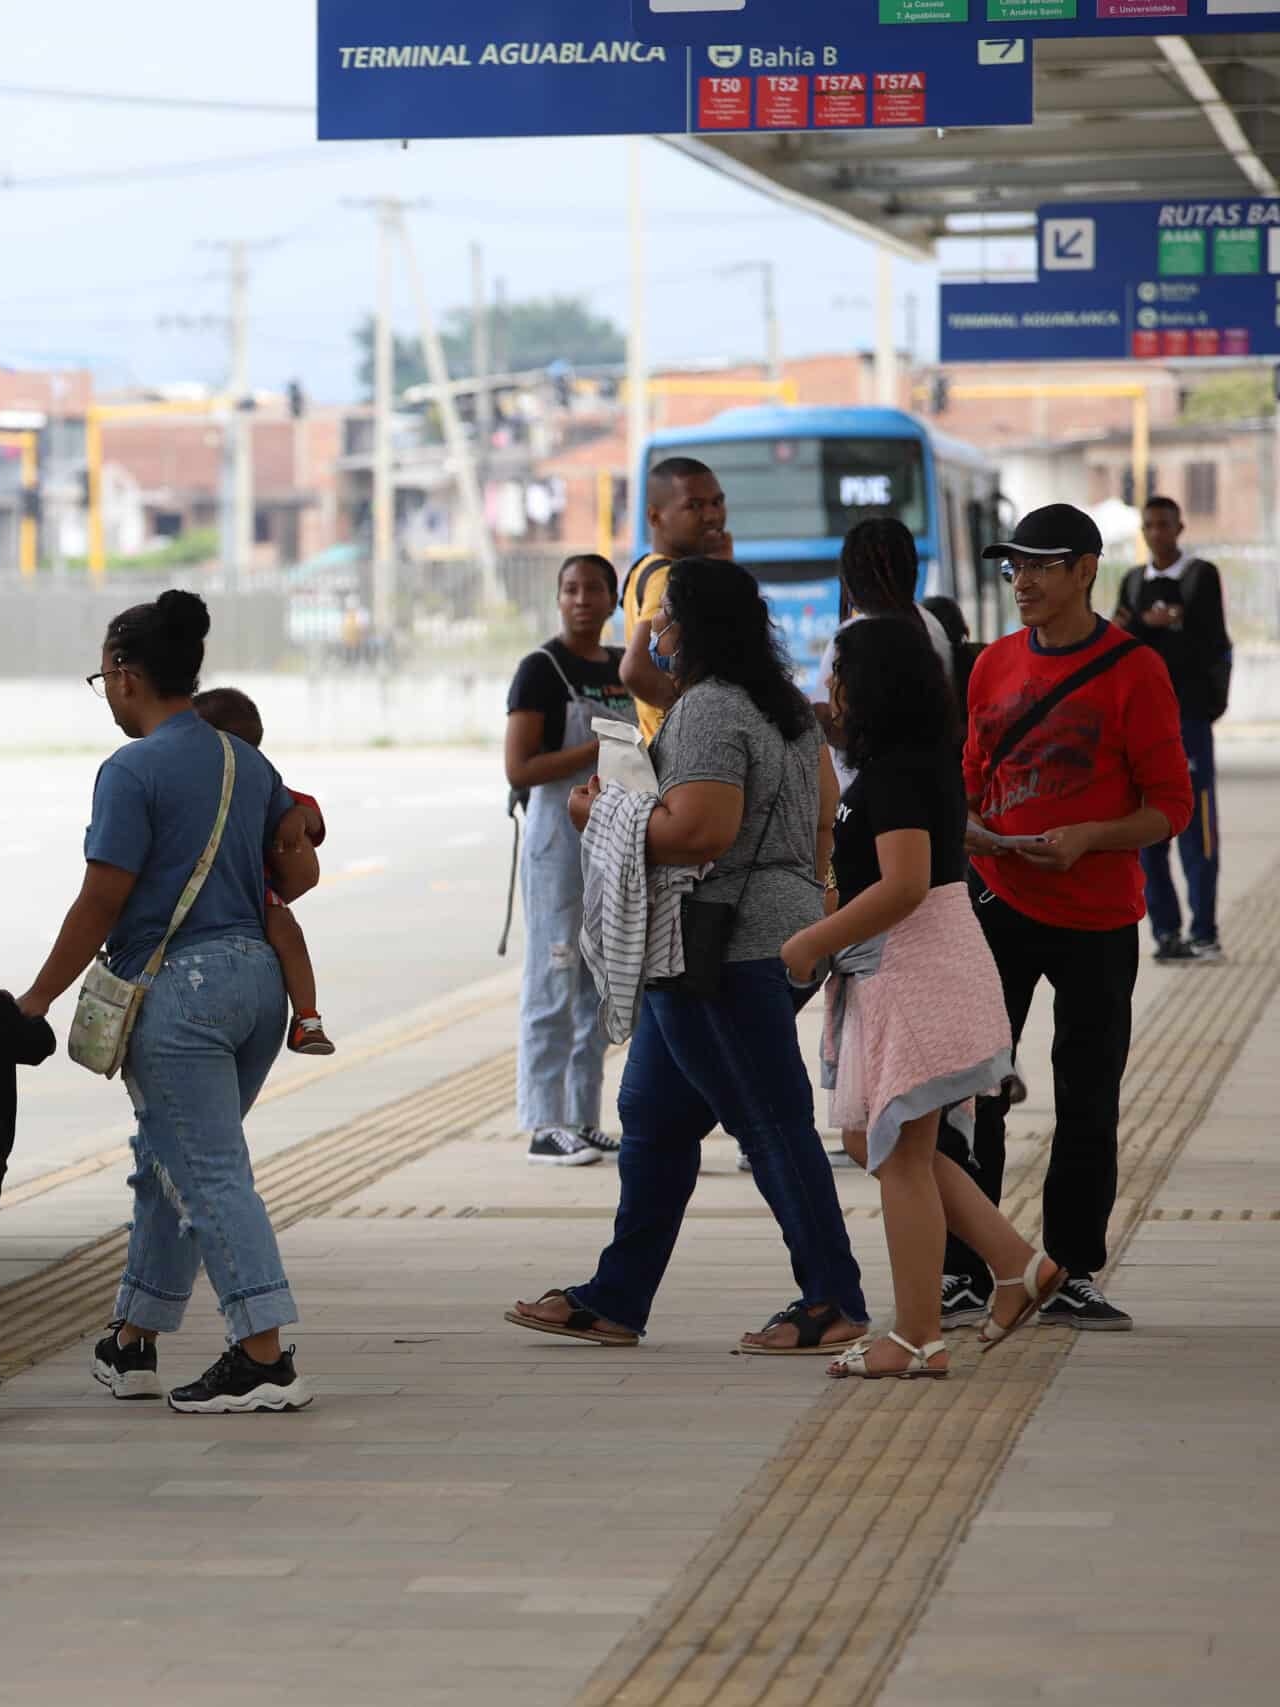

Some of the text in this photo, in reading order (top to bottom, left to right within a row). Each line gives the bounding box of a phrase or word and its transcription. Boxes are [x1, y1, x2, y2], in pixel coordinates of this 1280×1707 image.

[338, 41, 667, 69] TERMINAL AGUABLANCA
[748, 46, 838, 68] Bahía B
[710, 78, 741, 93] T50
[768, 76, 799, 91] T52
[818, 75, 864, 90] T57A
[877, 73, 922, 88] T57A
[1158, 204, 1241, 226] RUTAS
